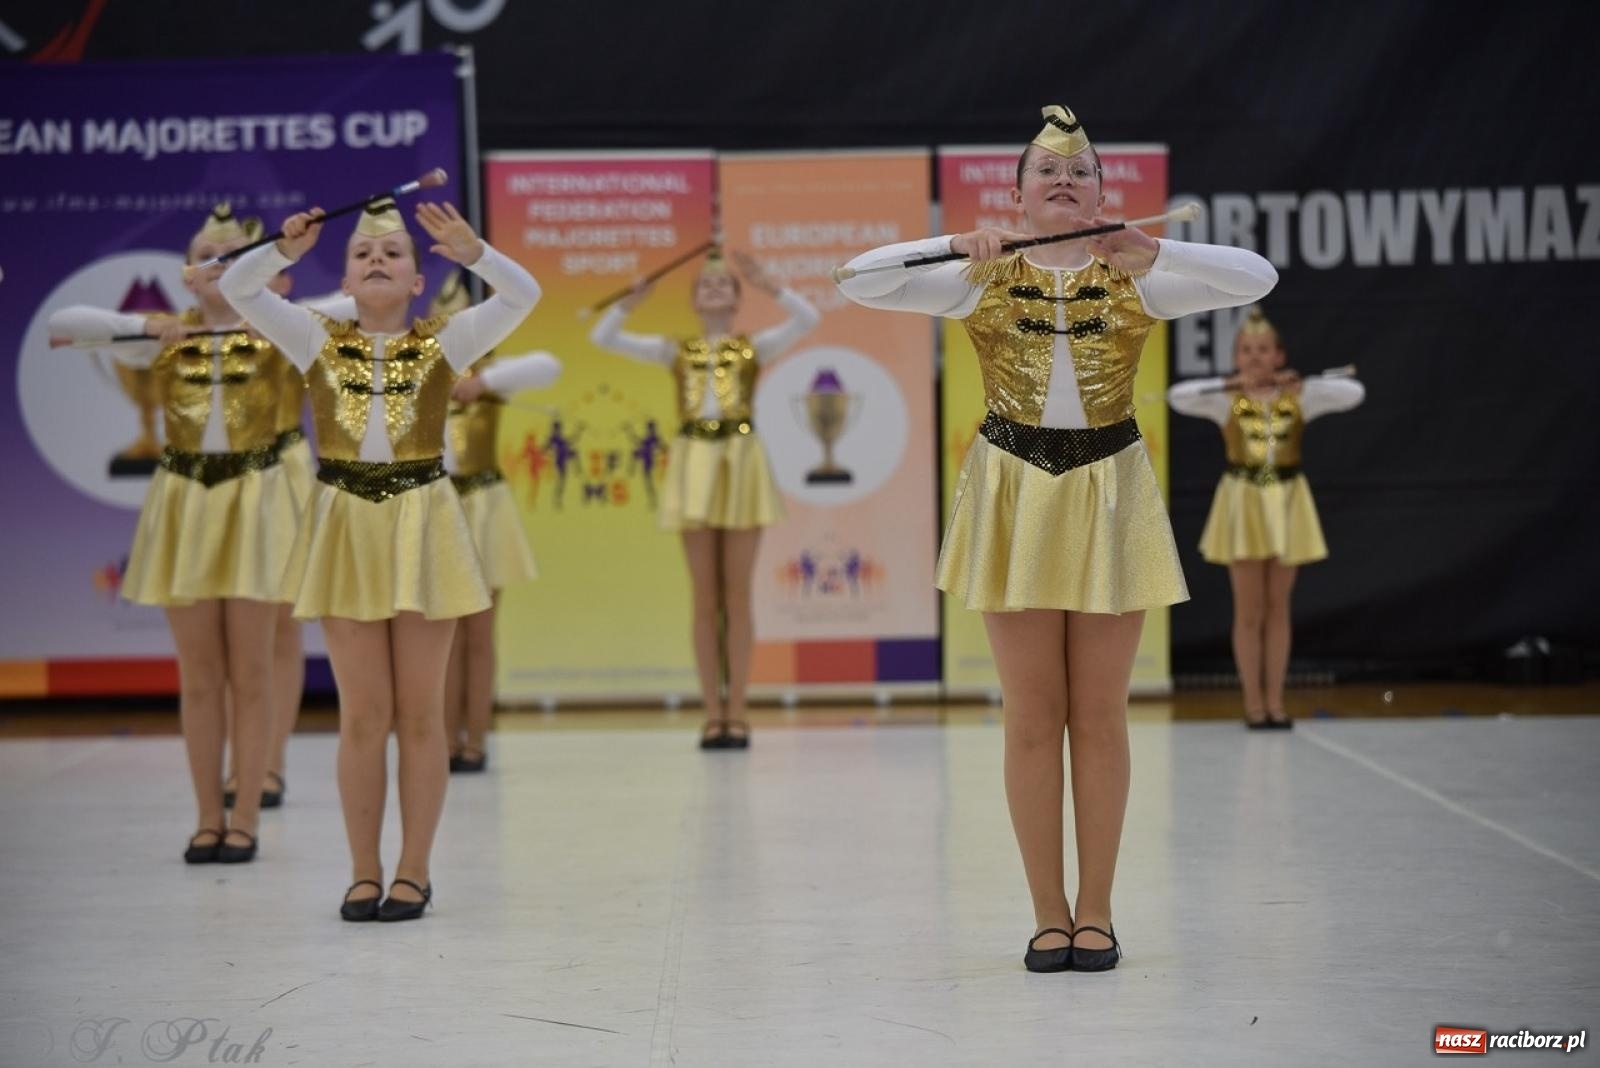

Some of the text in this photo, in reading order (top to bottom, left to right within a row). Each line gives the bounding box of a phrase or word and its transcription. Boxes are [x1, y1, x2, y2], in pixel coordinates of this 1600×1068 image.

[83, 114, 336, 160] MAJORETTES
[343, 110, 428, 148] CUP
[507, 173, 689, 194] INTERNATIONAL
[527, 200, 673, 221] FEDERATION
[523, 224, 677, 247] MAJORETTES
[749, 222, 900, 248] EUROPEAN
[561, 252, 639, 274] SPORT
